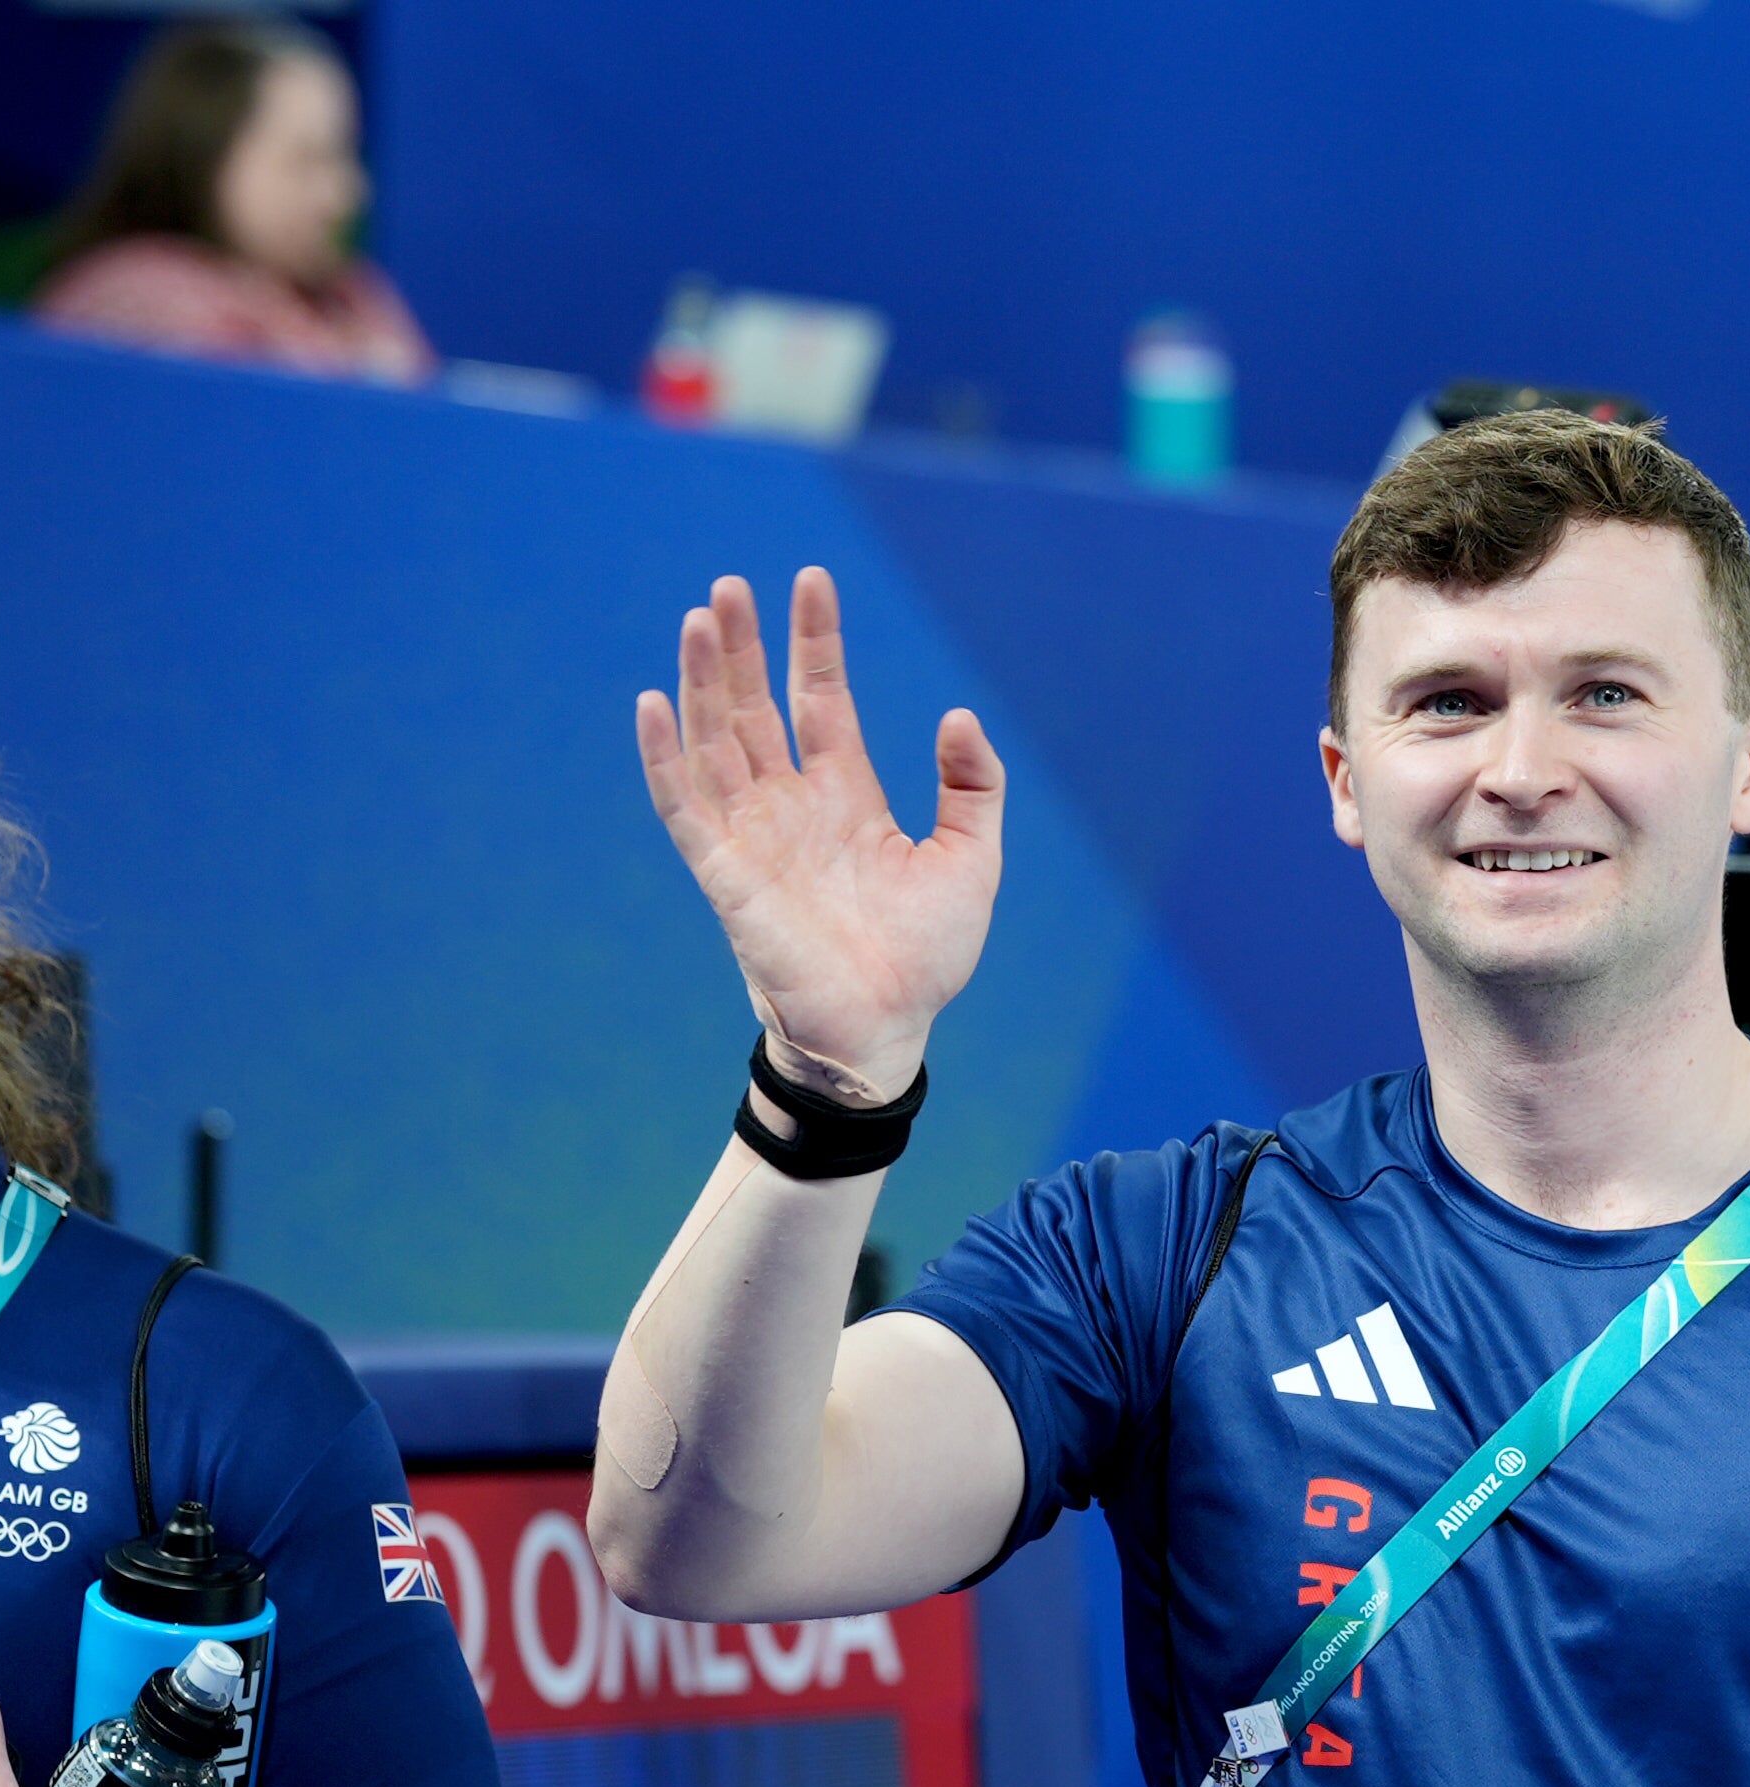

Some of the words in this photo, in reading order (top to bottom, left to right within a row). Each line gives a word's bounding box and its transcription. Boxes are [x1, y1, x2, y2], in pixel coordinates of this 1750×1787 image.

[49, 1487, 88, 1513] GB
[1435, 1472, 1503, 1540] Allianz
[1277, 1669, 1316, 1716] MILANO
[1312, 1619, 1364, 1672] CORTINA
[1360, 1588, 1388, 1619] 2026
